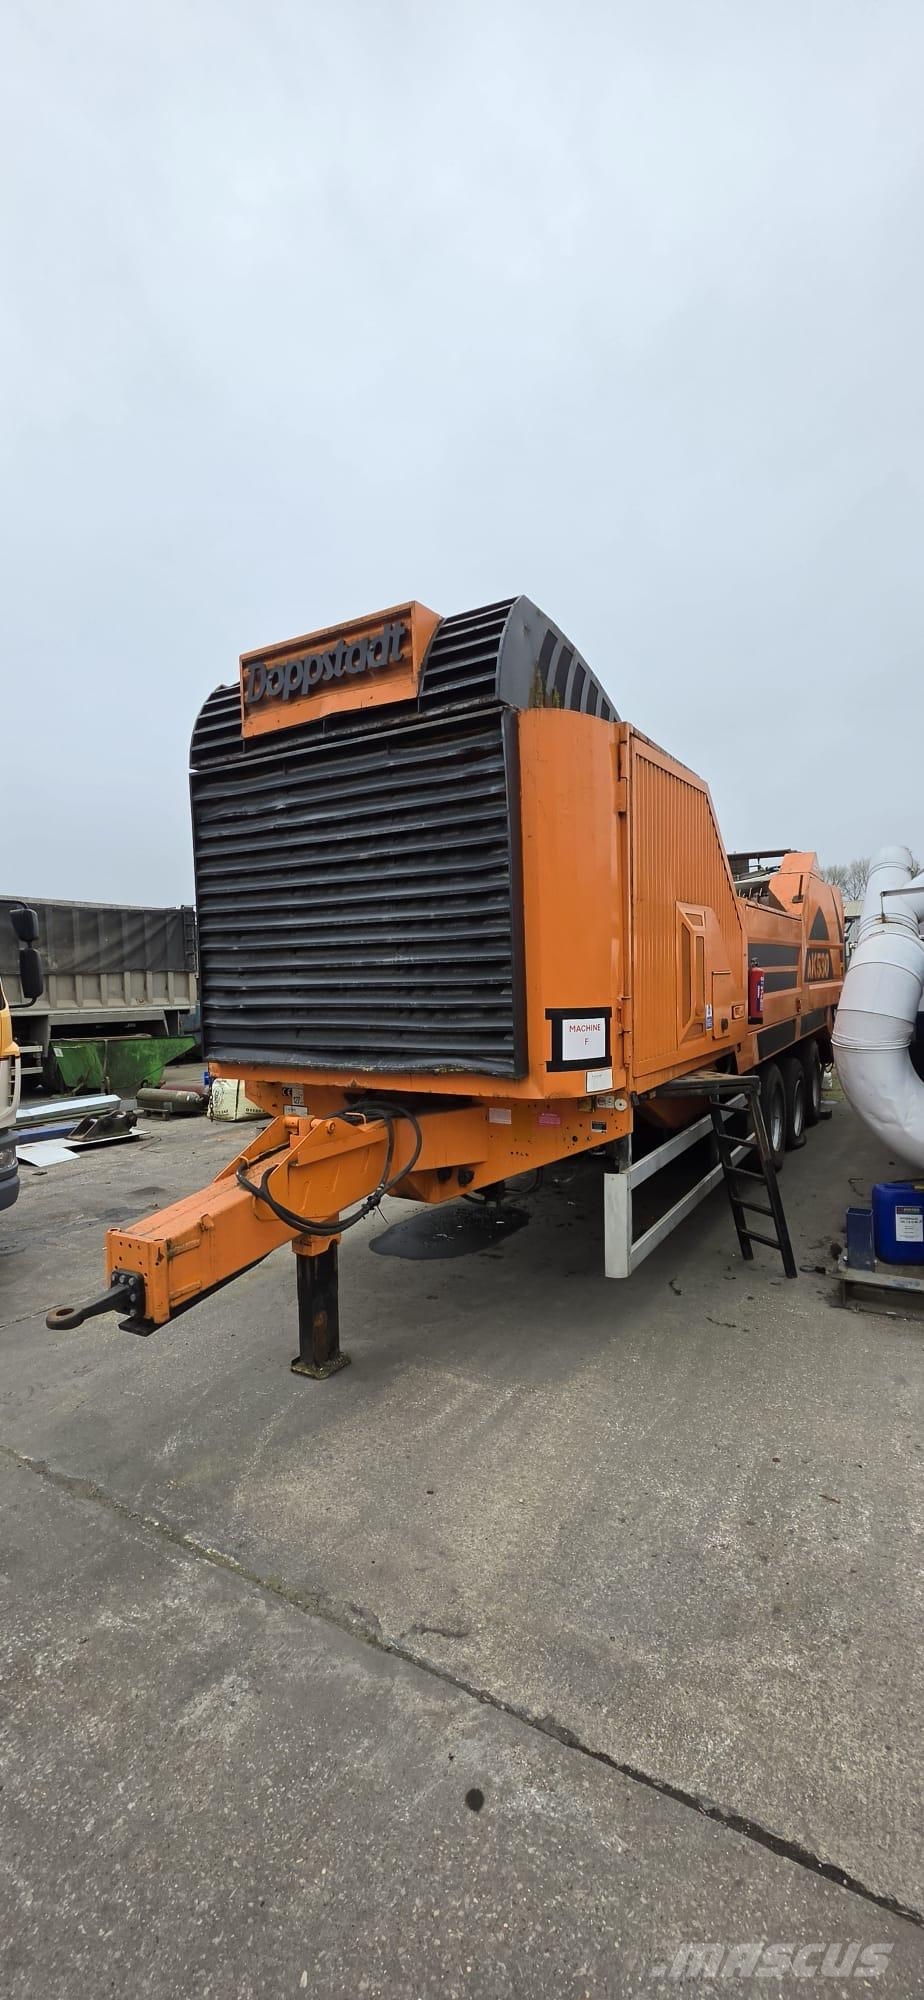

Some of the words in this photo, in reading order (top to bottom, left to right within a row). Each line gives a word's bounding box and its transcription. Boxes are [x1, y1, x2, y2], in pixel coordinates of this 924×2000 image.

[246, 621, 405, 703] Doppstadt
[569, 1023, 601, 1033] MACHINE
[584, 1037, 590, 1046] F
